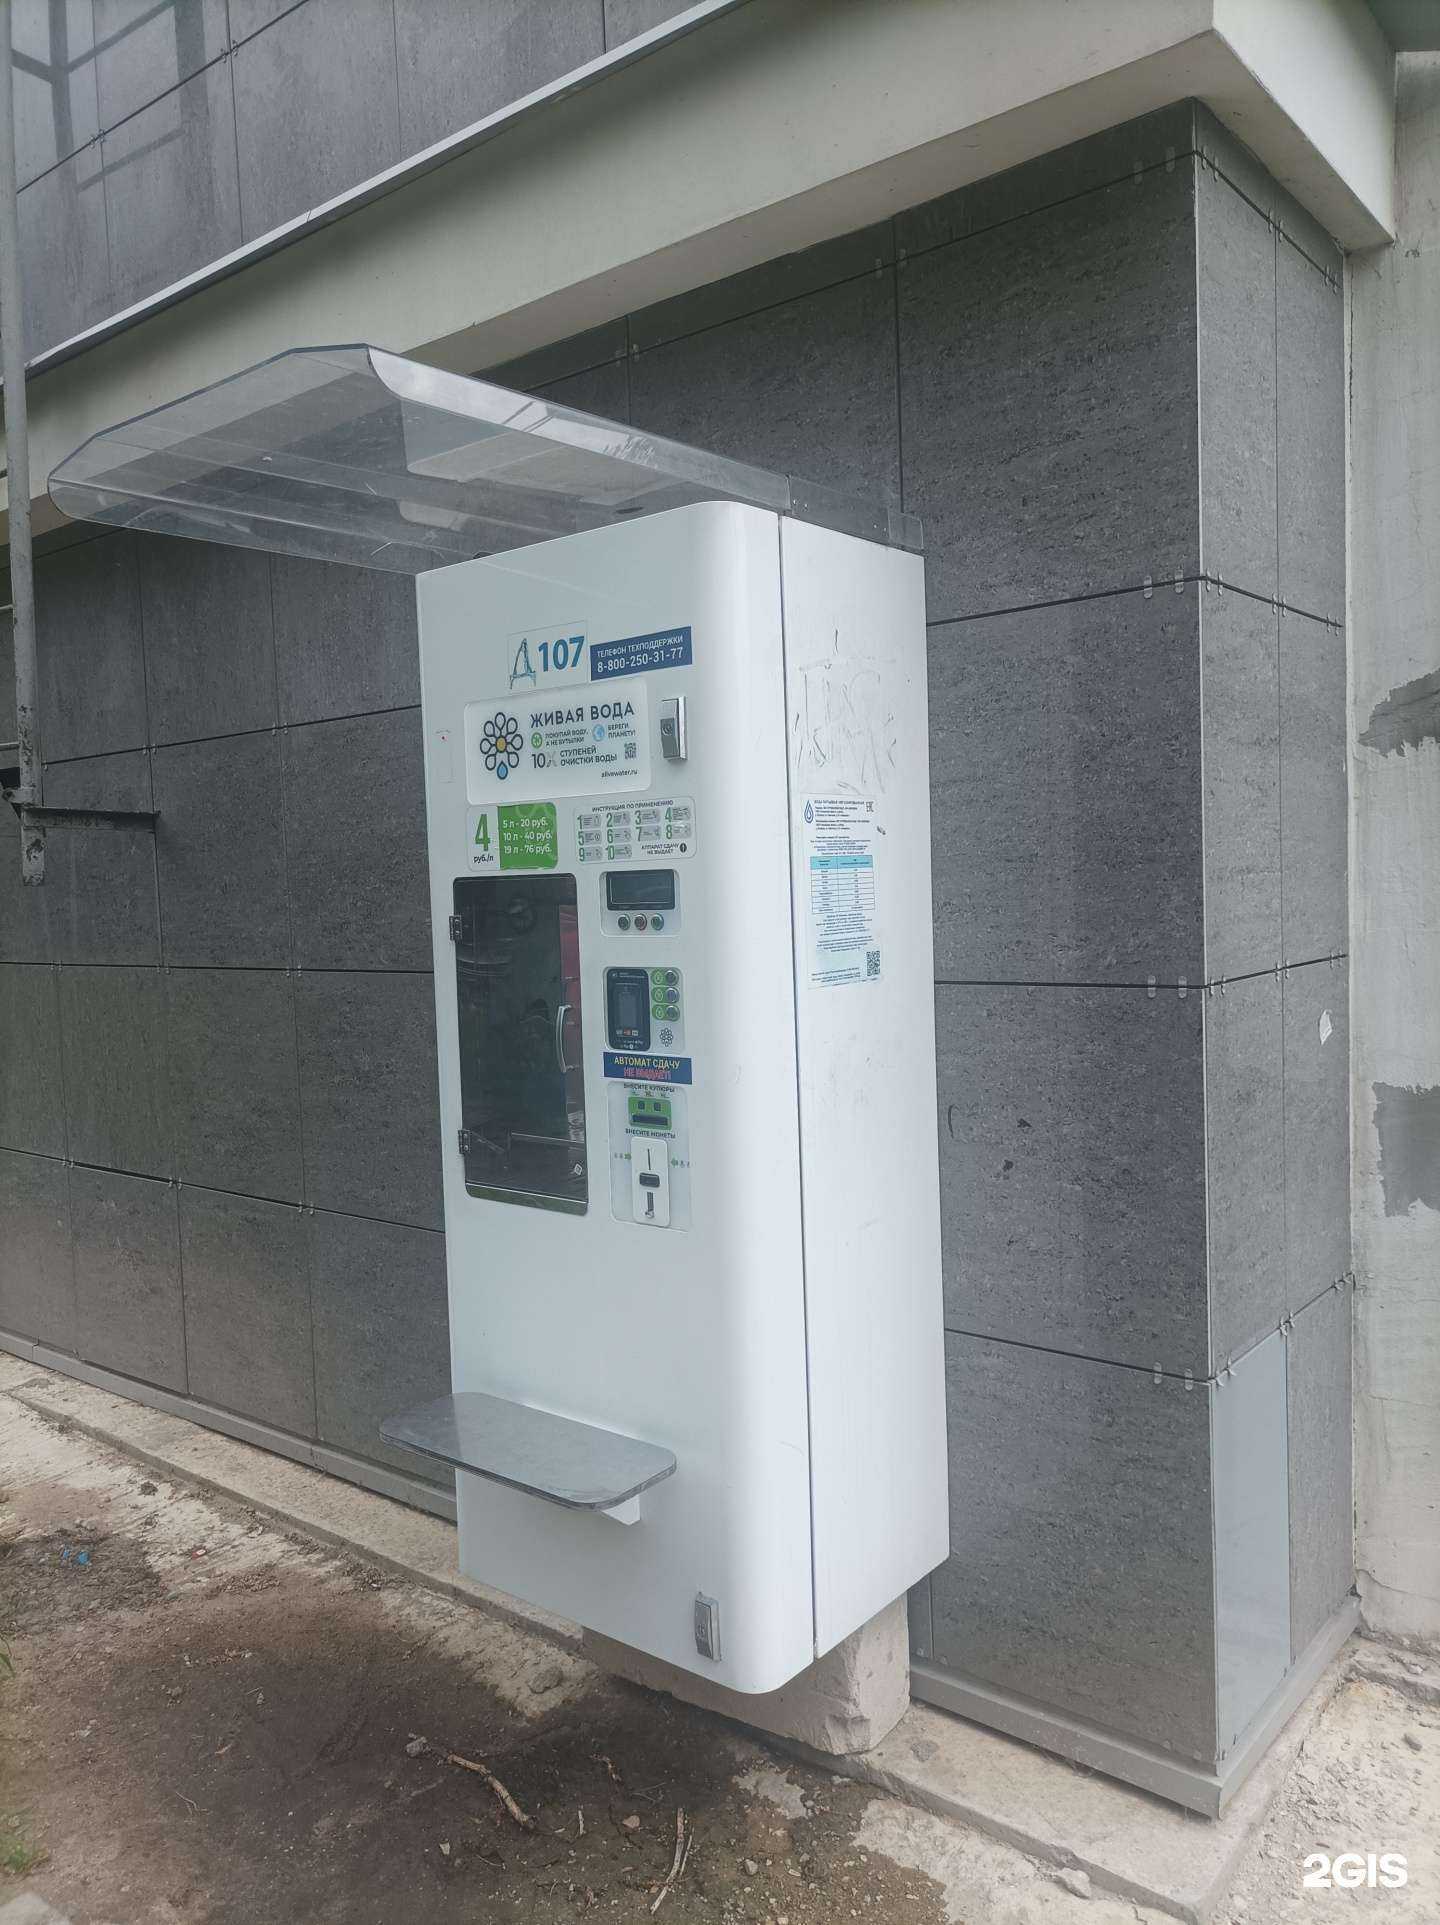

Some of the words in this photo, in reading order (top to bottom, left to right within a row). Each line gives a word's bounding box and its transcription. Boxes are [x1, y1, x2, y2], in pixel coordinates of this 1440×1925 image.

[597, 644, 626, 658] ТЕЛЕФОН
[627, 635, 683, 653] ТЕХПОДДЕРЖКИ
[538, 636, 584, 672] 107
[597, 647, 683, 673] 8-800-250-31-77
[531, 708, 584, 728] ЖИВАЯ
[591, 701, 634, 720] ВОДА
[560, 745, 596, 757] СТУПЕНЕЙ
[561, 756, 593, 766] ОЧИСТКИ
[596, 754, 617, 763] ВОДЫ
[601, 769, 637, 778] alivewater.ru
[606, 813, 613, 827] 2
[635, 810, 641, 825] 3
[665, 807, 672, 822] 4
[503, 820, 507, 828] 5
[521, 819, 530, 827] 20
[532, 817, 548, 828] руб.
[577, 815, 582, 829] 1
[475, 814, 490, 851] 4
[524, 832, 534, 840] 40
[536, 830, 552, 841] руб.
[578, 831, 584, 846] 5
[607, 829, 613, 843] 6
[636, 827, 642, 842] 7
[666, 825, 672, 839] 8
[504, 846, 511, 854] 19
[524, 845, 534, 853] 76
[536, 844, 552, 854] руб.
[579, 847, 584, 861] 9
[605, 845, 615, 860] 10
[615, 1057, 650, 1067] АВТОМАТ
[653, 1060, 680, 1069] СДАЧУ
[626, 1128, 649, 1136] ВНЕСИТЕ
